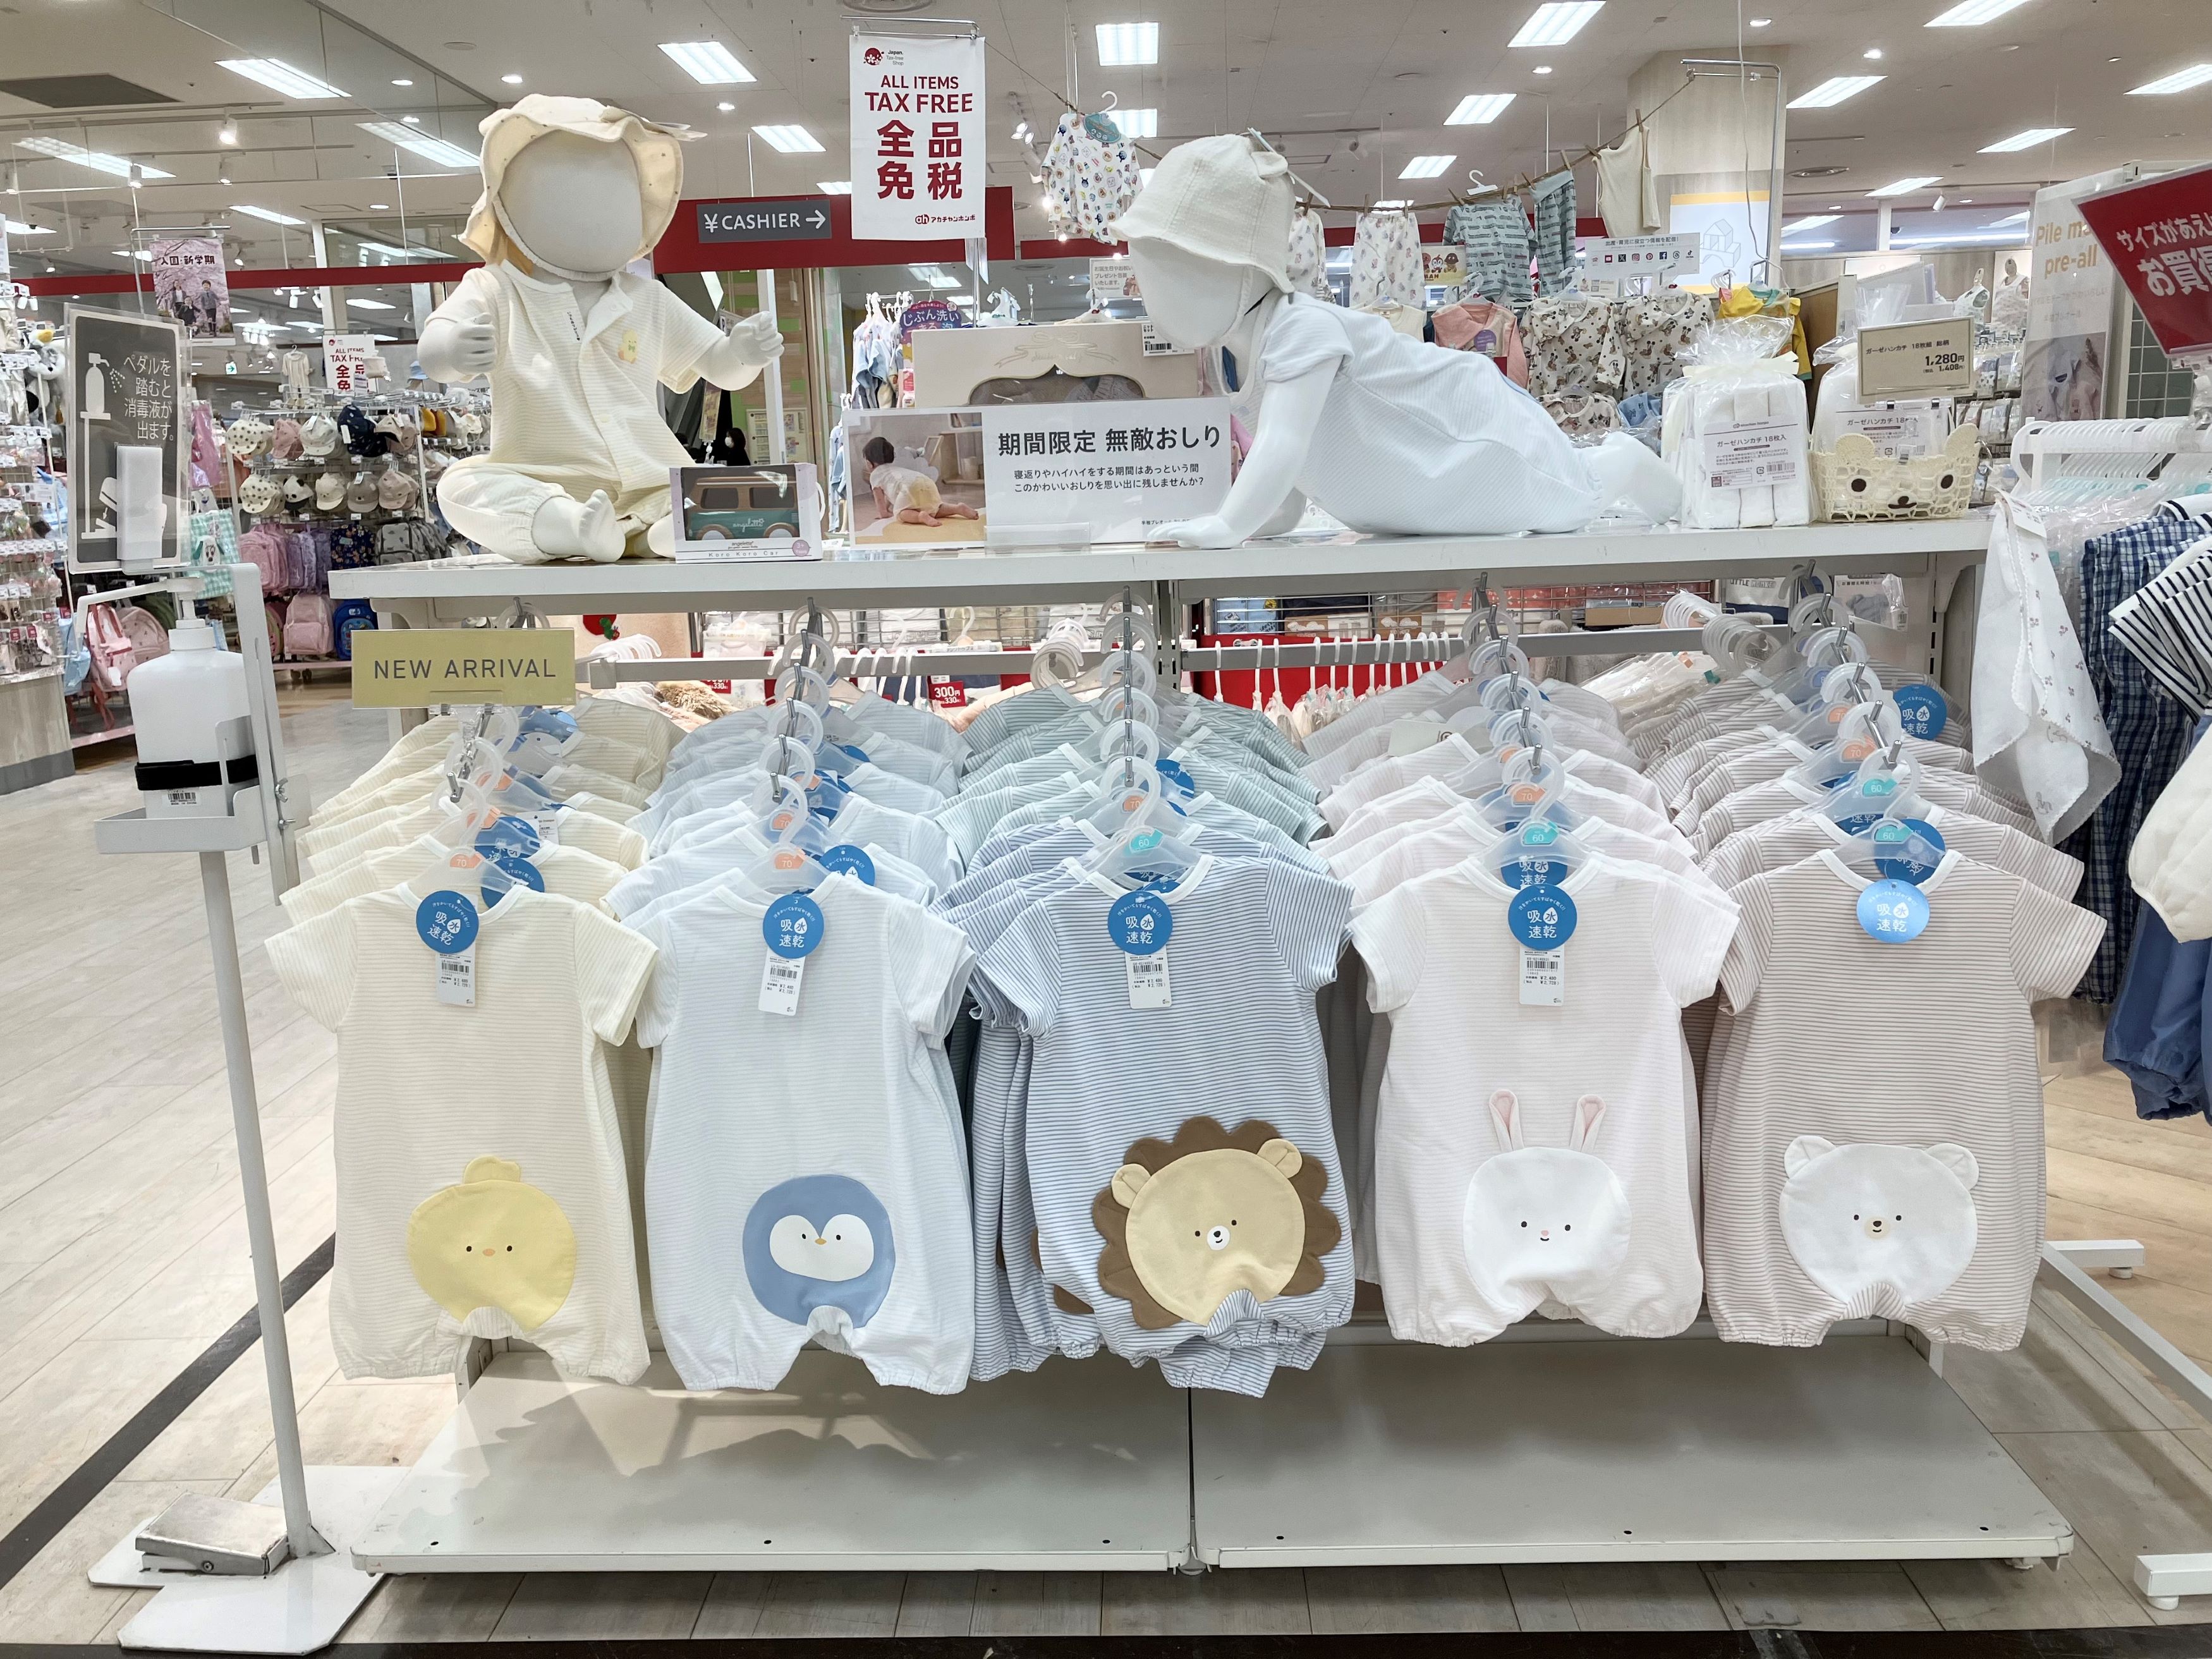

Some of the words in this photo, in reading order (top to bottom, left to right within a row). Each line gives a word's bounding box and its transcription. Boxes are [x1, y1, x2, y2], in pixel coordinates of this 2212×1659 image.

[880, 75, 909, 88] ALL
[914, 76, 959, 89] ITEMS
[864, 92, 910, 112] TAX
[916, 93, 973, 113] FREE
[877, 119, 962, 158] 全品
[877, 161, 963, 200] 免税
[2036, 222, 2062, 246] Pile
[2045, 243, 2098, 279] pre-all
[903, 309, 959, 327] じぶん洗い
[1865, 344, 1907, 355] ガーゼハンカチ
[123, 354, 171, 377] ペダルを
[330, 355, 347, 363] TAX
[1925, 353, 1965, 366] 1,280円
[136, 377, 171, 398] 踏むと
[125, 398, 173, 419] 消毒液が
[1847, 417, 1893, 426] ガーゼハンカチ
[137, 420, 174, 441] 出ます。
[998, 430, 1097, 457] 期間限定
[1106, 425, 1220, 453] 無敵おしり
[1717, 437, 1763, 447] ガーゼハンカチ
[1765, 434, 1787, 444] 18枚入
[1014, 463, 1200, 480] 寝返りやハイハイをする期間はあっという間
[374, 659, 432, 679] NEW
[444, 659, 556, 678] ARRIVAL
[934, 686, 961, 698] 300円
[1521, 793, 1533, 801] 70
[1138, 838, 1150, 847] 60
[1532, 834, 1543, 842] 60
[456, 859, 467, 867] 70
[1527, 909, 1557, 923] 吸水
[1876, 903, 1908, 917] 吸水
[435, 911, 461, 933] 吸水
[781, 918, 806, 933] 吸水
[1125, 915, 1153, 929] 吸水
[1876, 919, 1907, 933] 速乾
[427, 924, 454, 945] 速乾
[1126, 931, 1153, 945] 速乾
[1528, 925, 1557, 939] 速乾
[779, 933, 805, 948] 速乾
